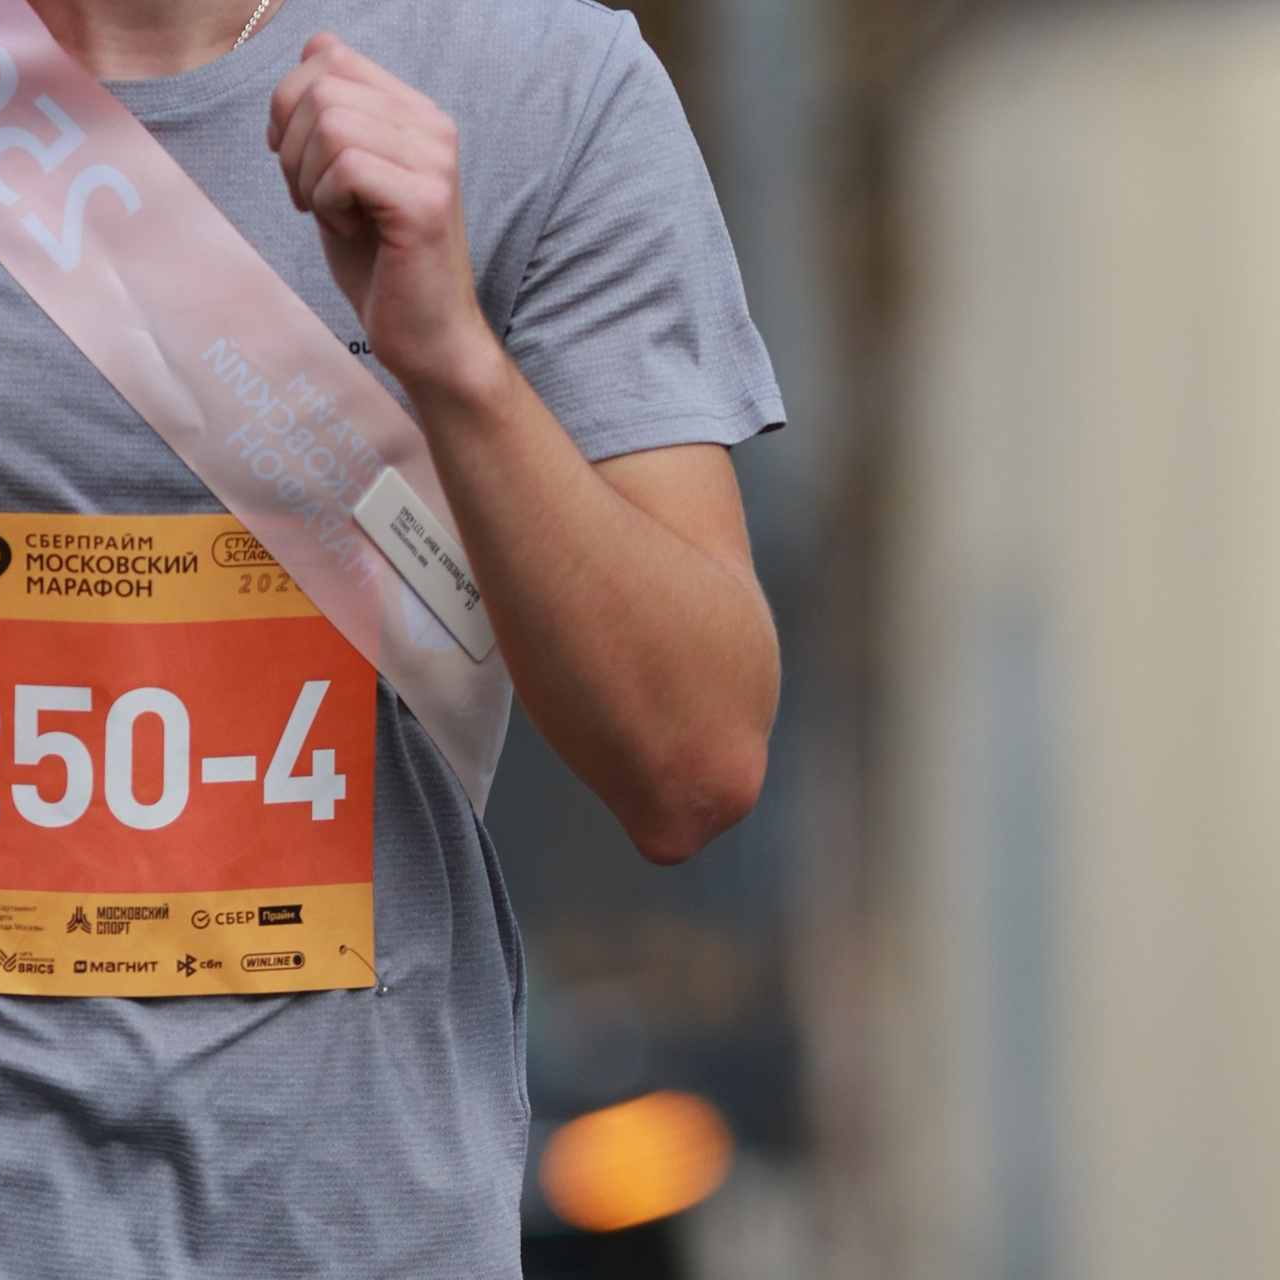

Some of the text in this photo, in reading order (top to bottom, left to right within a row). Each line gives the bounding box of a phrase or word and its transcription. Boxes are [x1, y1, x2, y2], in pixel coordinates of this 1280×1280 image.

[25, 532, 154, 551] СБЕРПРАЙМ
[225, 537, 264, 549] СТУД
[25, 551, 199, 575] МОСКОВСКИЙ
[25, 577, 153, 599] МАРАФОН
[238, 572, 303, 594] 202
[96, 903, 170, 920] МОСКОВСКИЙ
[215, 911, 255, 925] СБЕР
[96, 921, 132, 935] СПОРТ
[18, 963, 55, 975] BRICS
[246, 955, 291, 968] WINLINE
